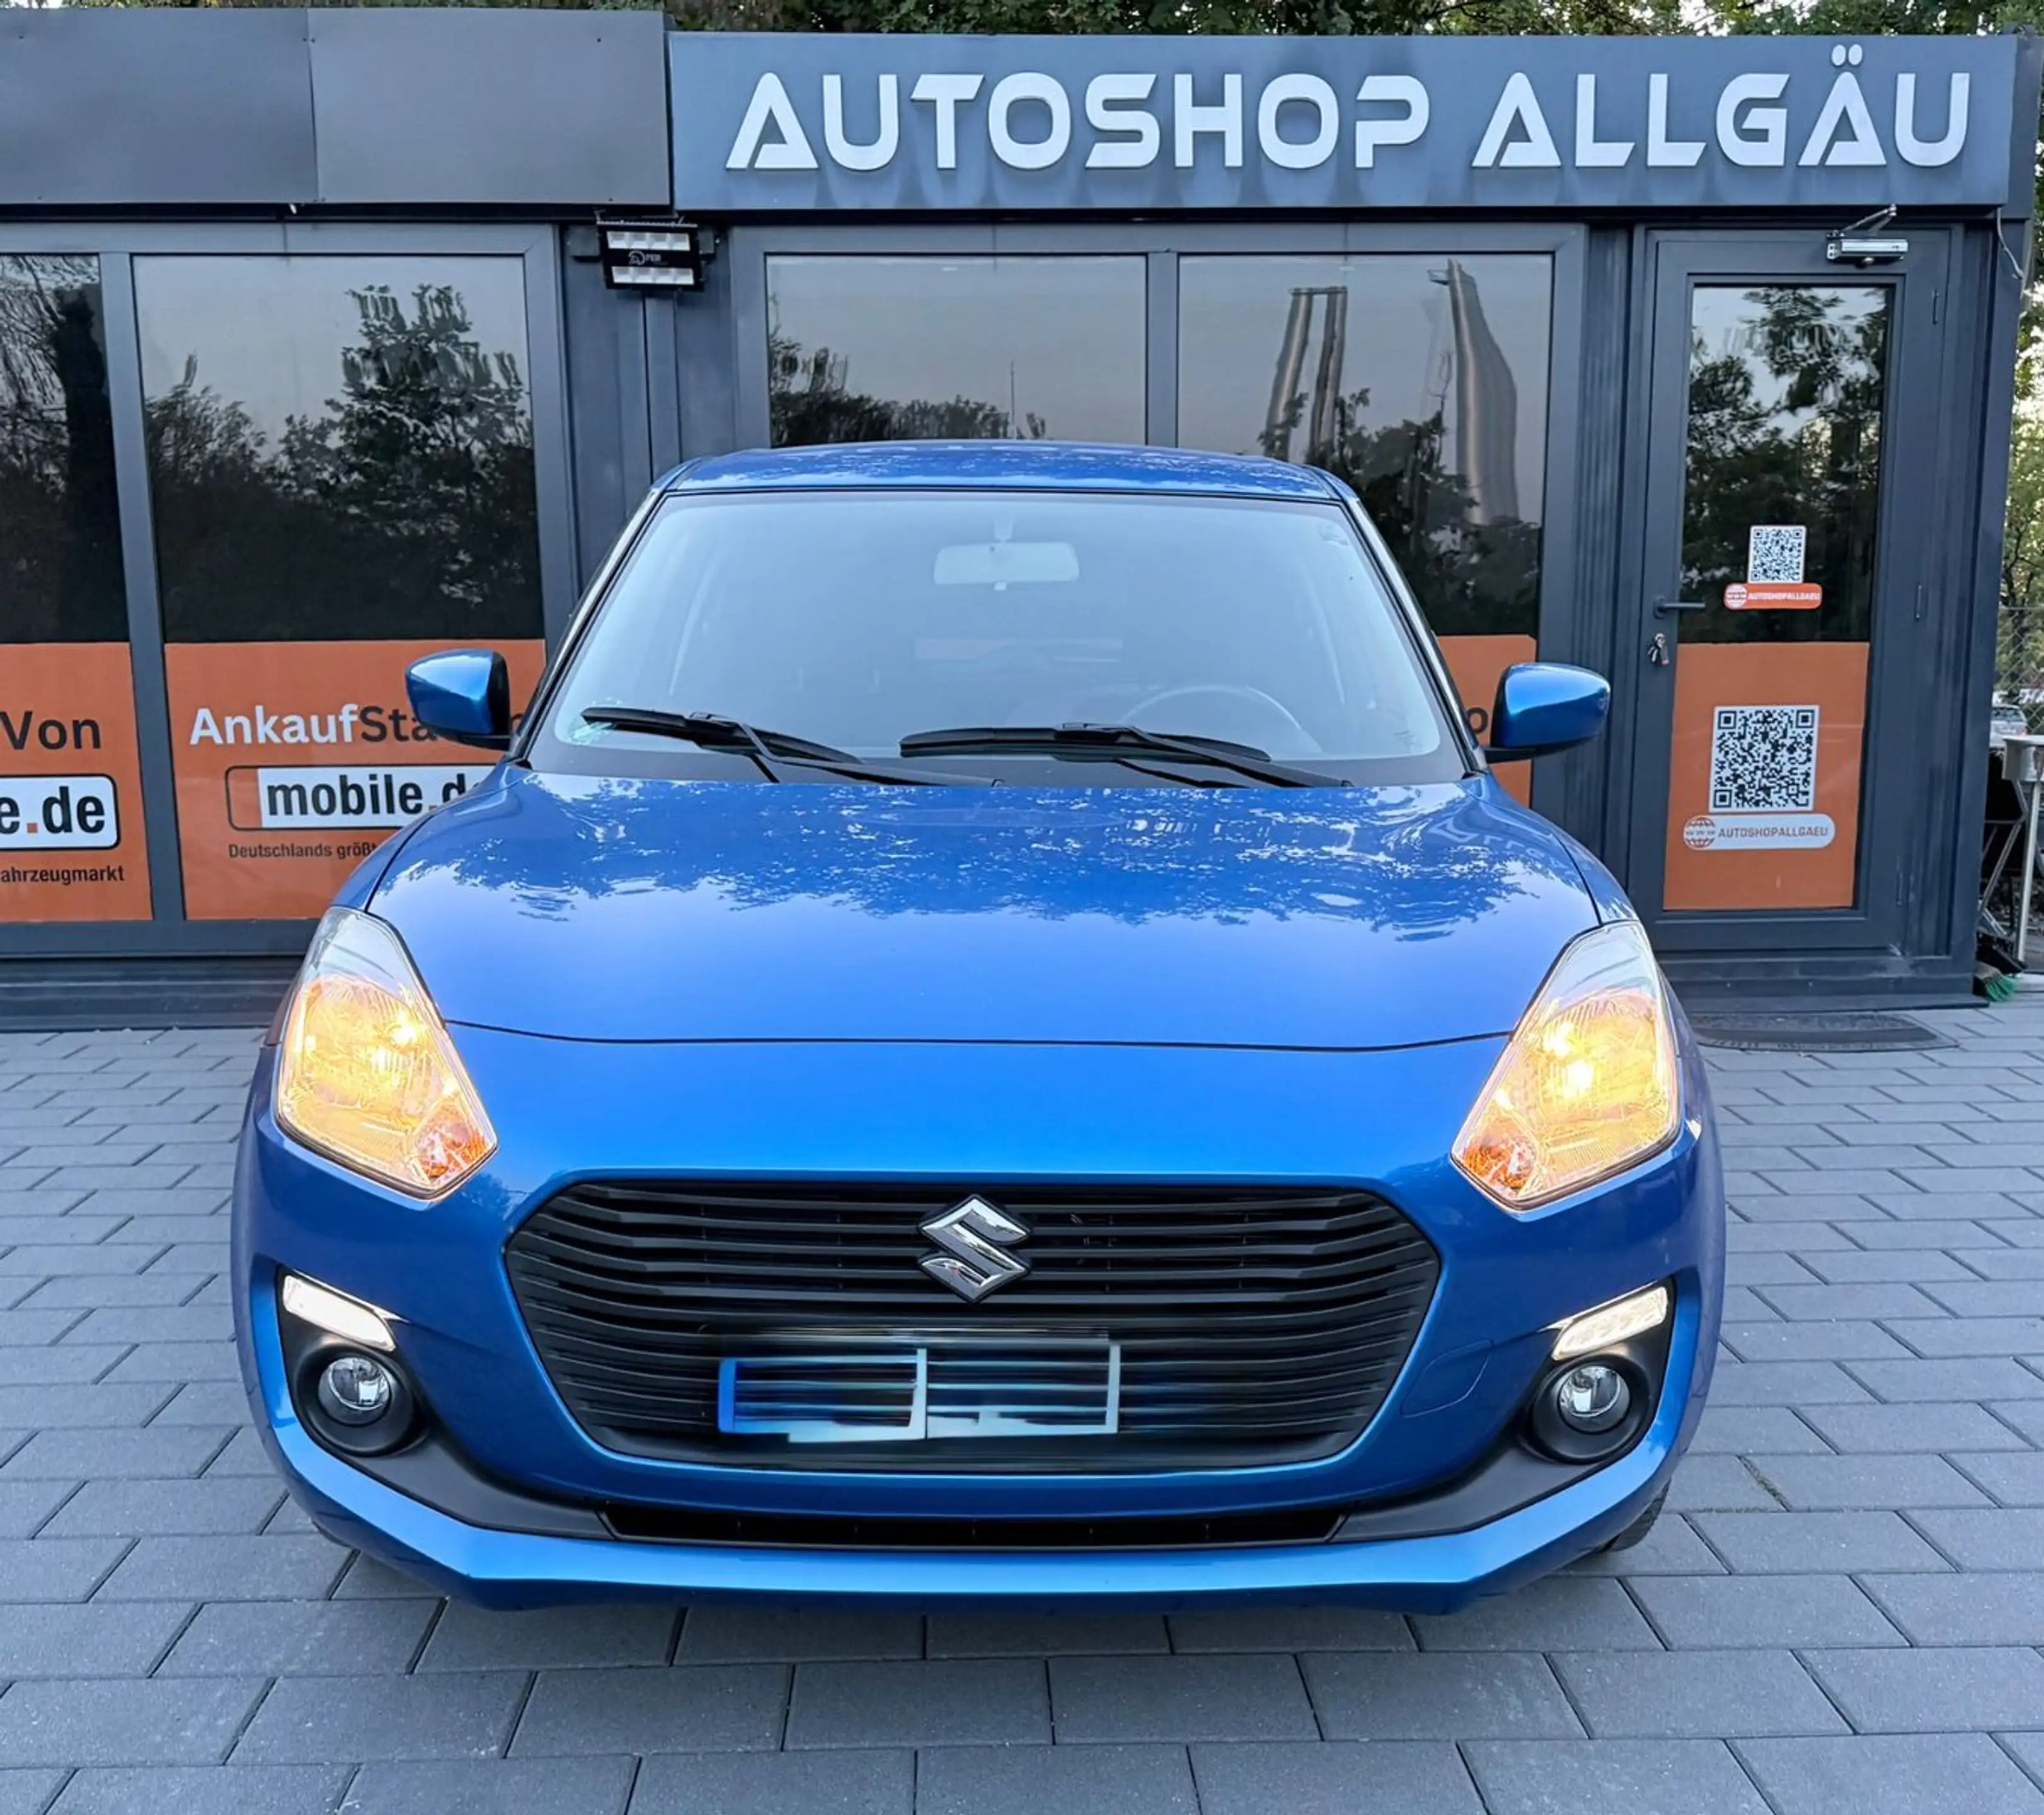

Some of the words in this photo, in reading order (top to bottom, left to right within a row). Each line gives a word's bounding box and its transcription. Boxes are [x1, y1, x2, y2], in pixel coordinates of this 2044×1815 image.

[726, 72, 1430, 170] AUTOSHOP
[1472, 44, 1970, 168] ALLGÄU
[0, 711, 101, 749] Von
[228, 843, 332, 858] Deutschlands
